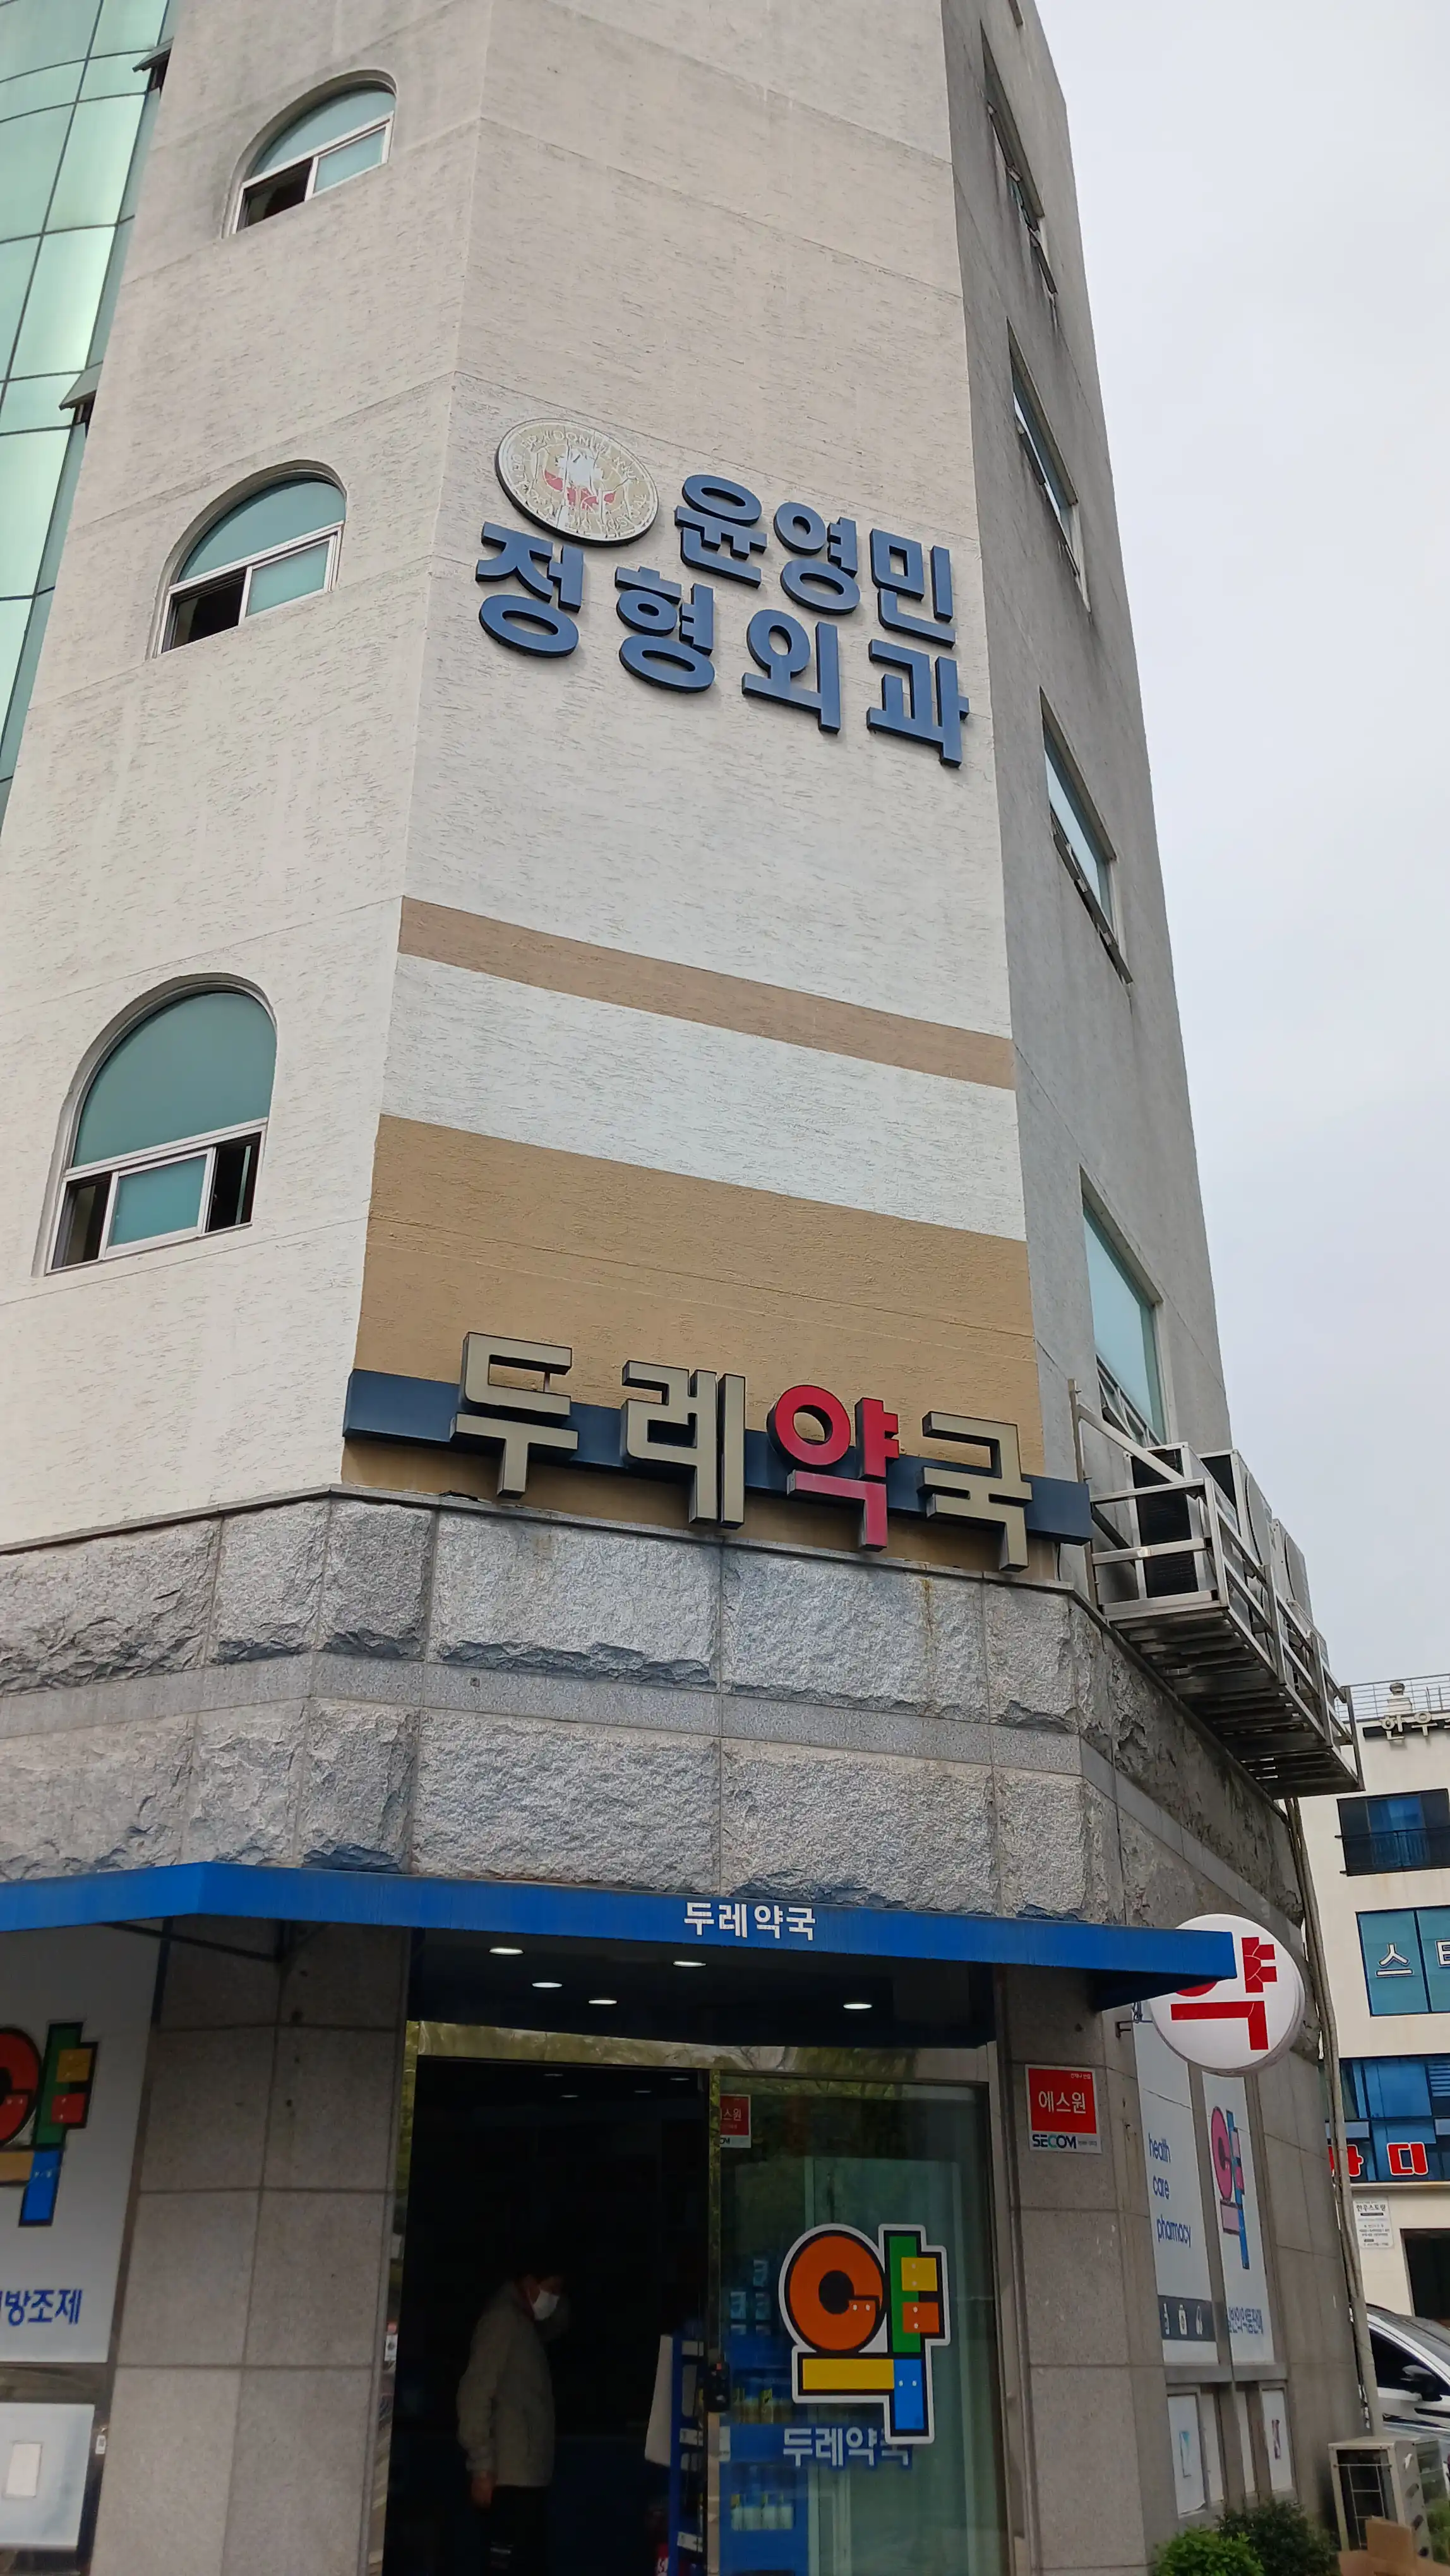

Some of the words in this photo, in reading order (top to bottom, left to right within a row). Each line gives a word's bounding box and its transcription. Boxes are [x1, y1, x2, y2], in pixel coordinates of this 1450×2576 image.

[674, 474, 956, 648] 윤영민
[475, 522, 970, 768] 정형외과
[450, 1331, 1033, 1572] 두레약국
[684, 1902, 816, 1941] 두레약국
[720, 2108, 743, 2121] 스원
[1038, 2090, 1086, 2114] 에스원
[1032, 2134, 1077, 2149] SECOM
[1148, 2133, 1171, 2164] health
[1153, 2175, 1170, 2200] care
[1156, 2214, 1191, 2248] pharmacy
[0, 2288, 83, 2326] 방조제
[779, 2224, 950, 2445] 약
